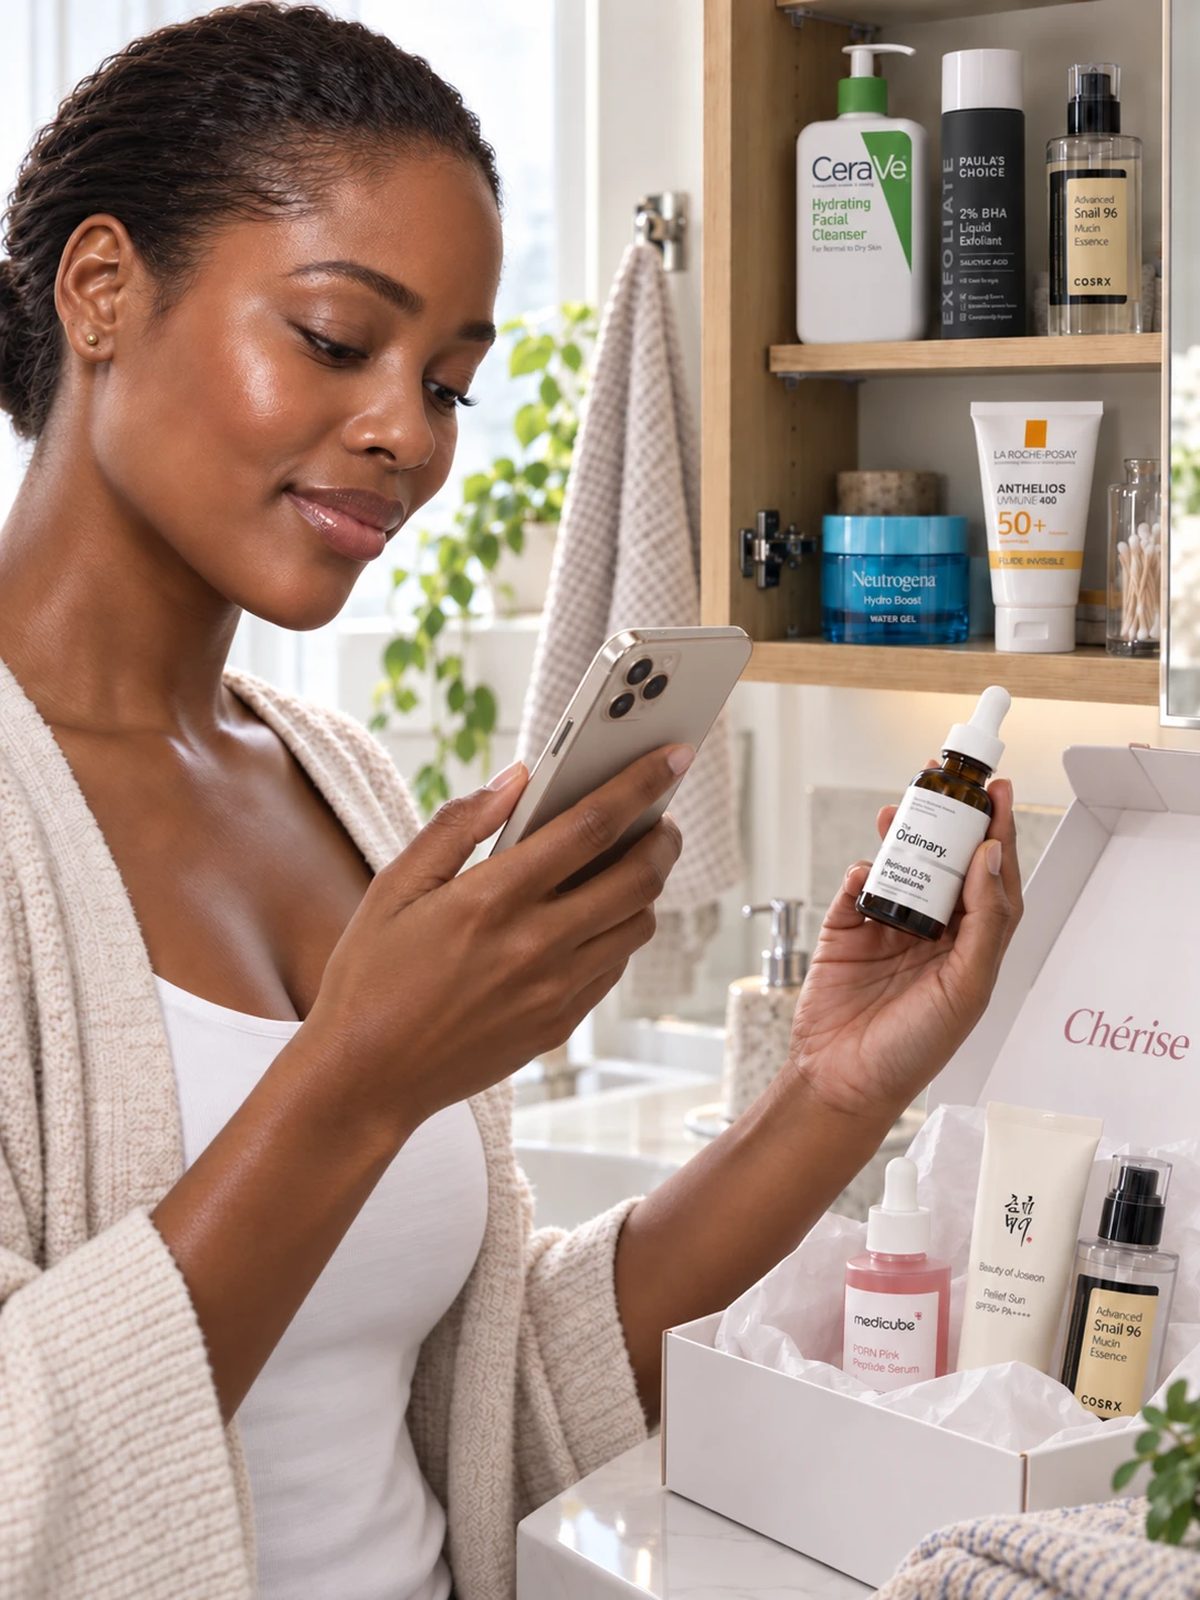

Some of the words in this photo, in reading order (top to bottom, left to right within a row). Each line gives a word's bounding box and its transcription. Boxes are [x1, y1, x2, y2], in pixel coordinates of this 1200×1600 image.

[960, 156, 1005, 166] PAULA'S
[812, 154, 906, 181] CeraVe
[959, 168, 1005, 178] CHOICE
[812, 198, 871, 213] Hydrating
[1074, 196, 1115, 204] Advanced
[960, 208, 978, 219] 2%
[982, 208, 1007, 218] BHA
[1074, 207, 1100, 218] Snail
[1104, 208, 1118, 218] 96
[812, 213, 848, 225] Facial
[812, 228, 867, 240] Cleanser
[960, 222, 991, 236] Liquid
[1074, 224, 1100, 233] Mucin
[960, 235, 1002, 247] Exfoliant
[1074, 237, 1109, 246] Essence
[1074, 278, 1112, 286] COSRX
[994, 450, 1006, 459] LA
[1008, 450, 1077, 460] ROCHE-POSAY
[997, 484, 1066, 494] ANTHELIOS
[1040, 496, 1057, 505] 400
[998, 511, 1046, 535] 50+
[852, 571, 936, 592] Neutrogena
[864, 596, 892, 607] Hydro
[894, 596, 922, 605] Boost
[870, 615, 898, 623] WATER
[900, 615, 916, 623] GEL
[896, 828, 947, 858] Ordinary.
[1064, 1008, 1190, 1060] Chérise
[979, 1262, 1004, 1277] Beauty
[1004, 1268, 1014, 1276] of
[1014, 1271, 1045, 1283] Joseon
[1008, 1293, 1026, 1305] Sun
[1096, 1306, 1143, 1323] Advanced
[854, 1315, 915, 1331] medicube
[1094, 1319, 1123, 1336] Snail
[1126, 1325, 1142, 1337] 96
[1092, 1335, 1120, 1348] Mucin
[879, 1349, 899, 1360] Pink
[1090, 1347, 1127, 1362] Essence
[887, 1363, 920, 1374] Serum
[1081, 1395, 1122, 1412] COSRX
